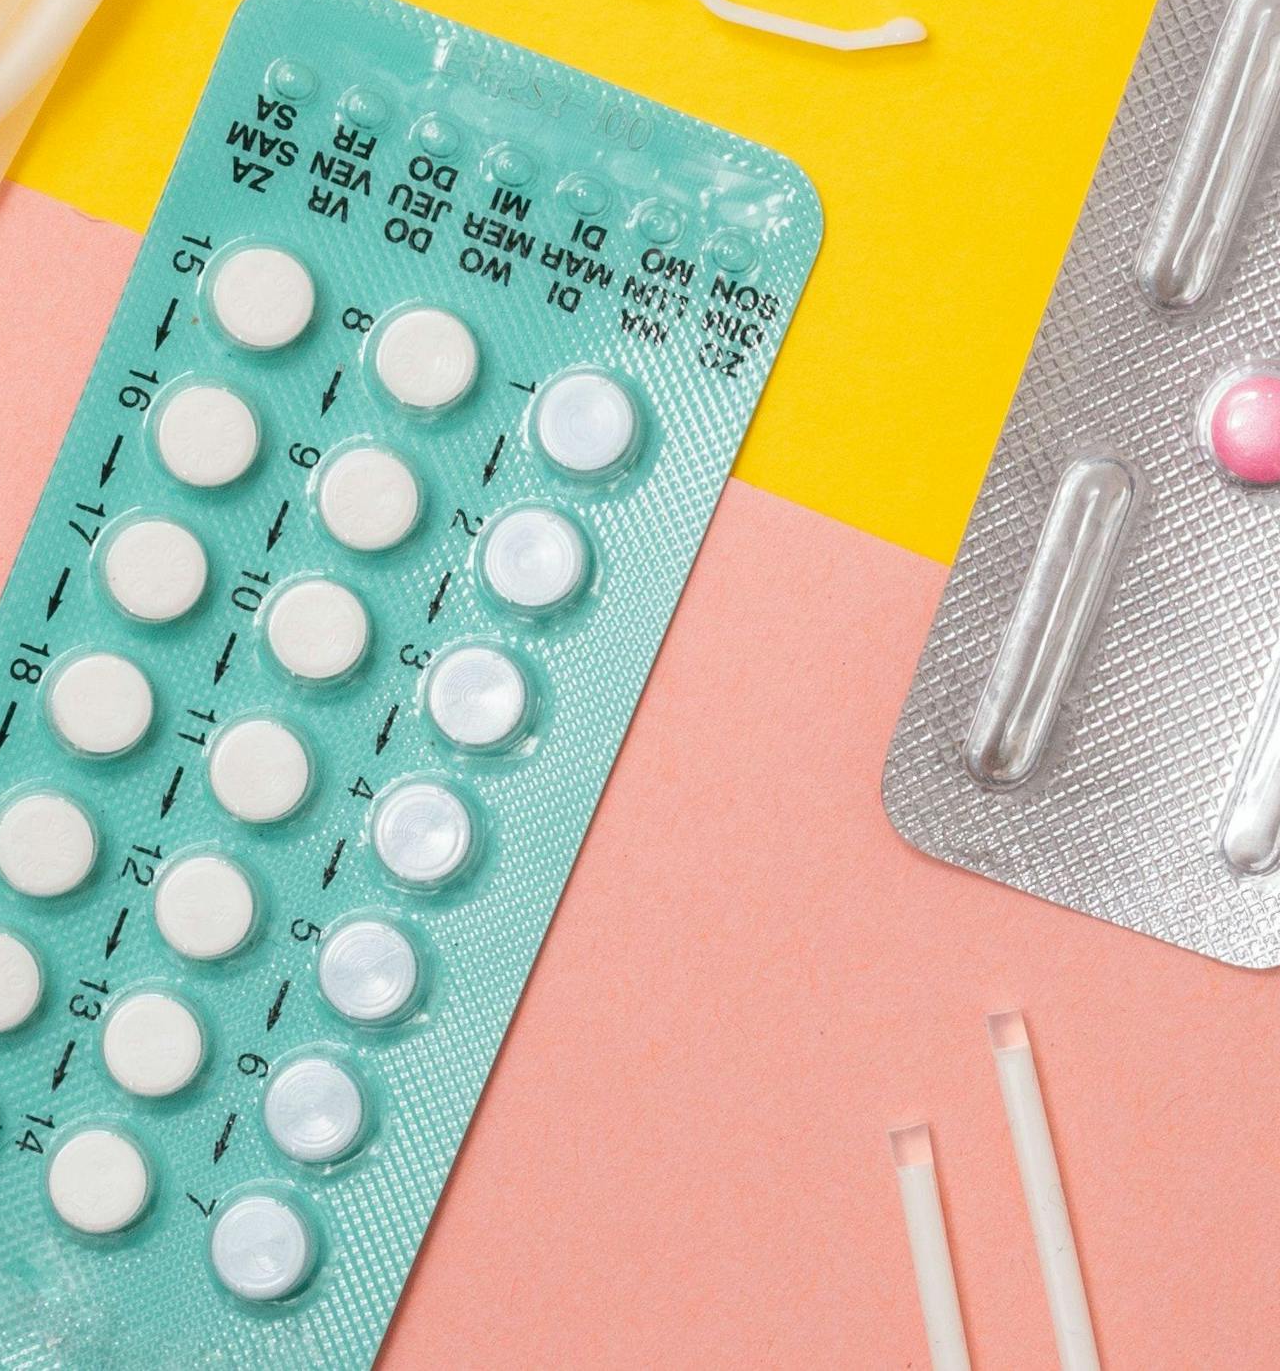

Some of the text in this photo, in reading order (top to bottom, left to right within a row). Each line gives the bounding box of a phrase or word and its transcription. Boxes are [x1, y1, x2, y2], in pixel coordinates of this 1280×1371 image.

[257, 94, 780, 321] SON MO DI MI DO FR SA
[225, 120, 765, 349] DIM LUN MAR MER JEU VEN SAM
[172, 235, 213, 277] 15
[232, 156, 745, 379] ZO MA DI WO DO VR ZA
[342, 307, 375, 333] 8
[119, 369, 159, 412] 16
[288, 442, 321, 470] 9
[68, 502, 107, 547] 17
[451, 508, 484, 537] 2
[231, 570, 272, 613] 10
[10, 642, 51, 685] 18
[399, 644, 432, 669] 3
[177, 709, 217, 746] 11
[347, 776, 375, 800] 4
[121, 845, 162, 886] 12
[290, 918, 322, 947] 5
[69, 979, 110, 1021] 13
[237, 1053, 269, 1078] 6
[16, 1114, 56, 1154] 14
[186, 1192, 217, 1219] 7
